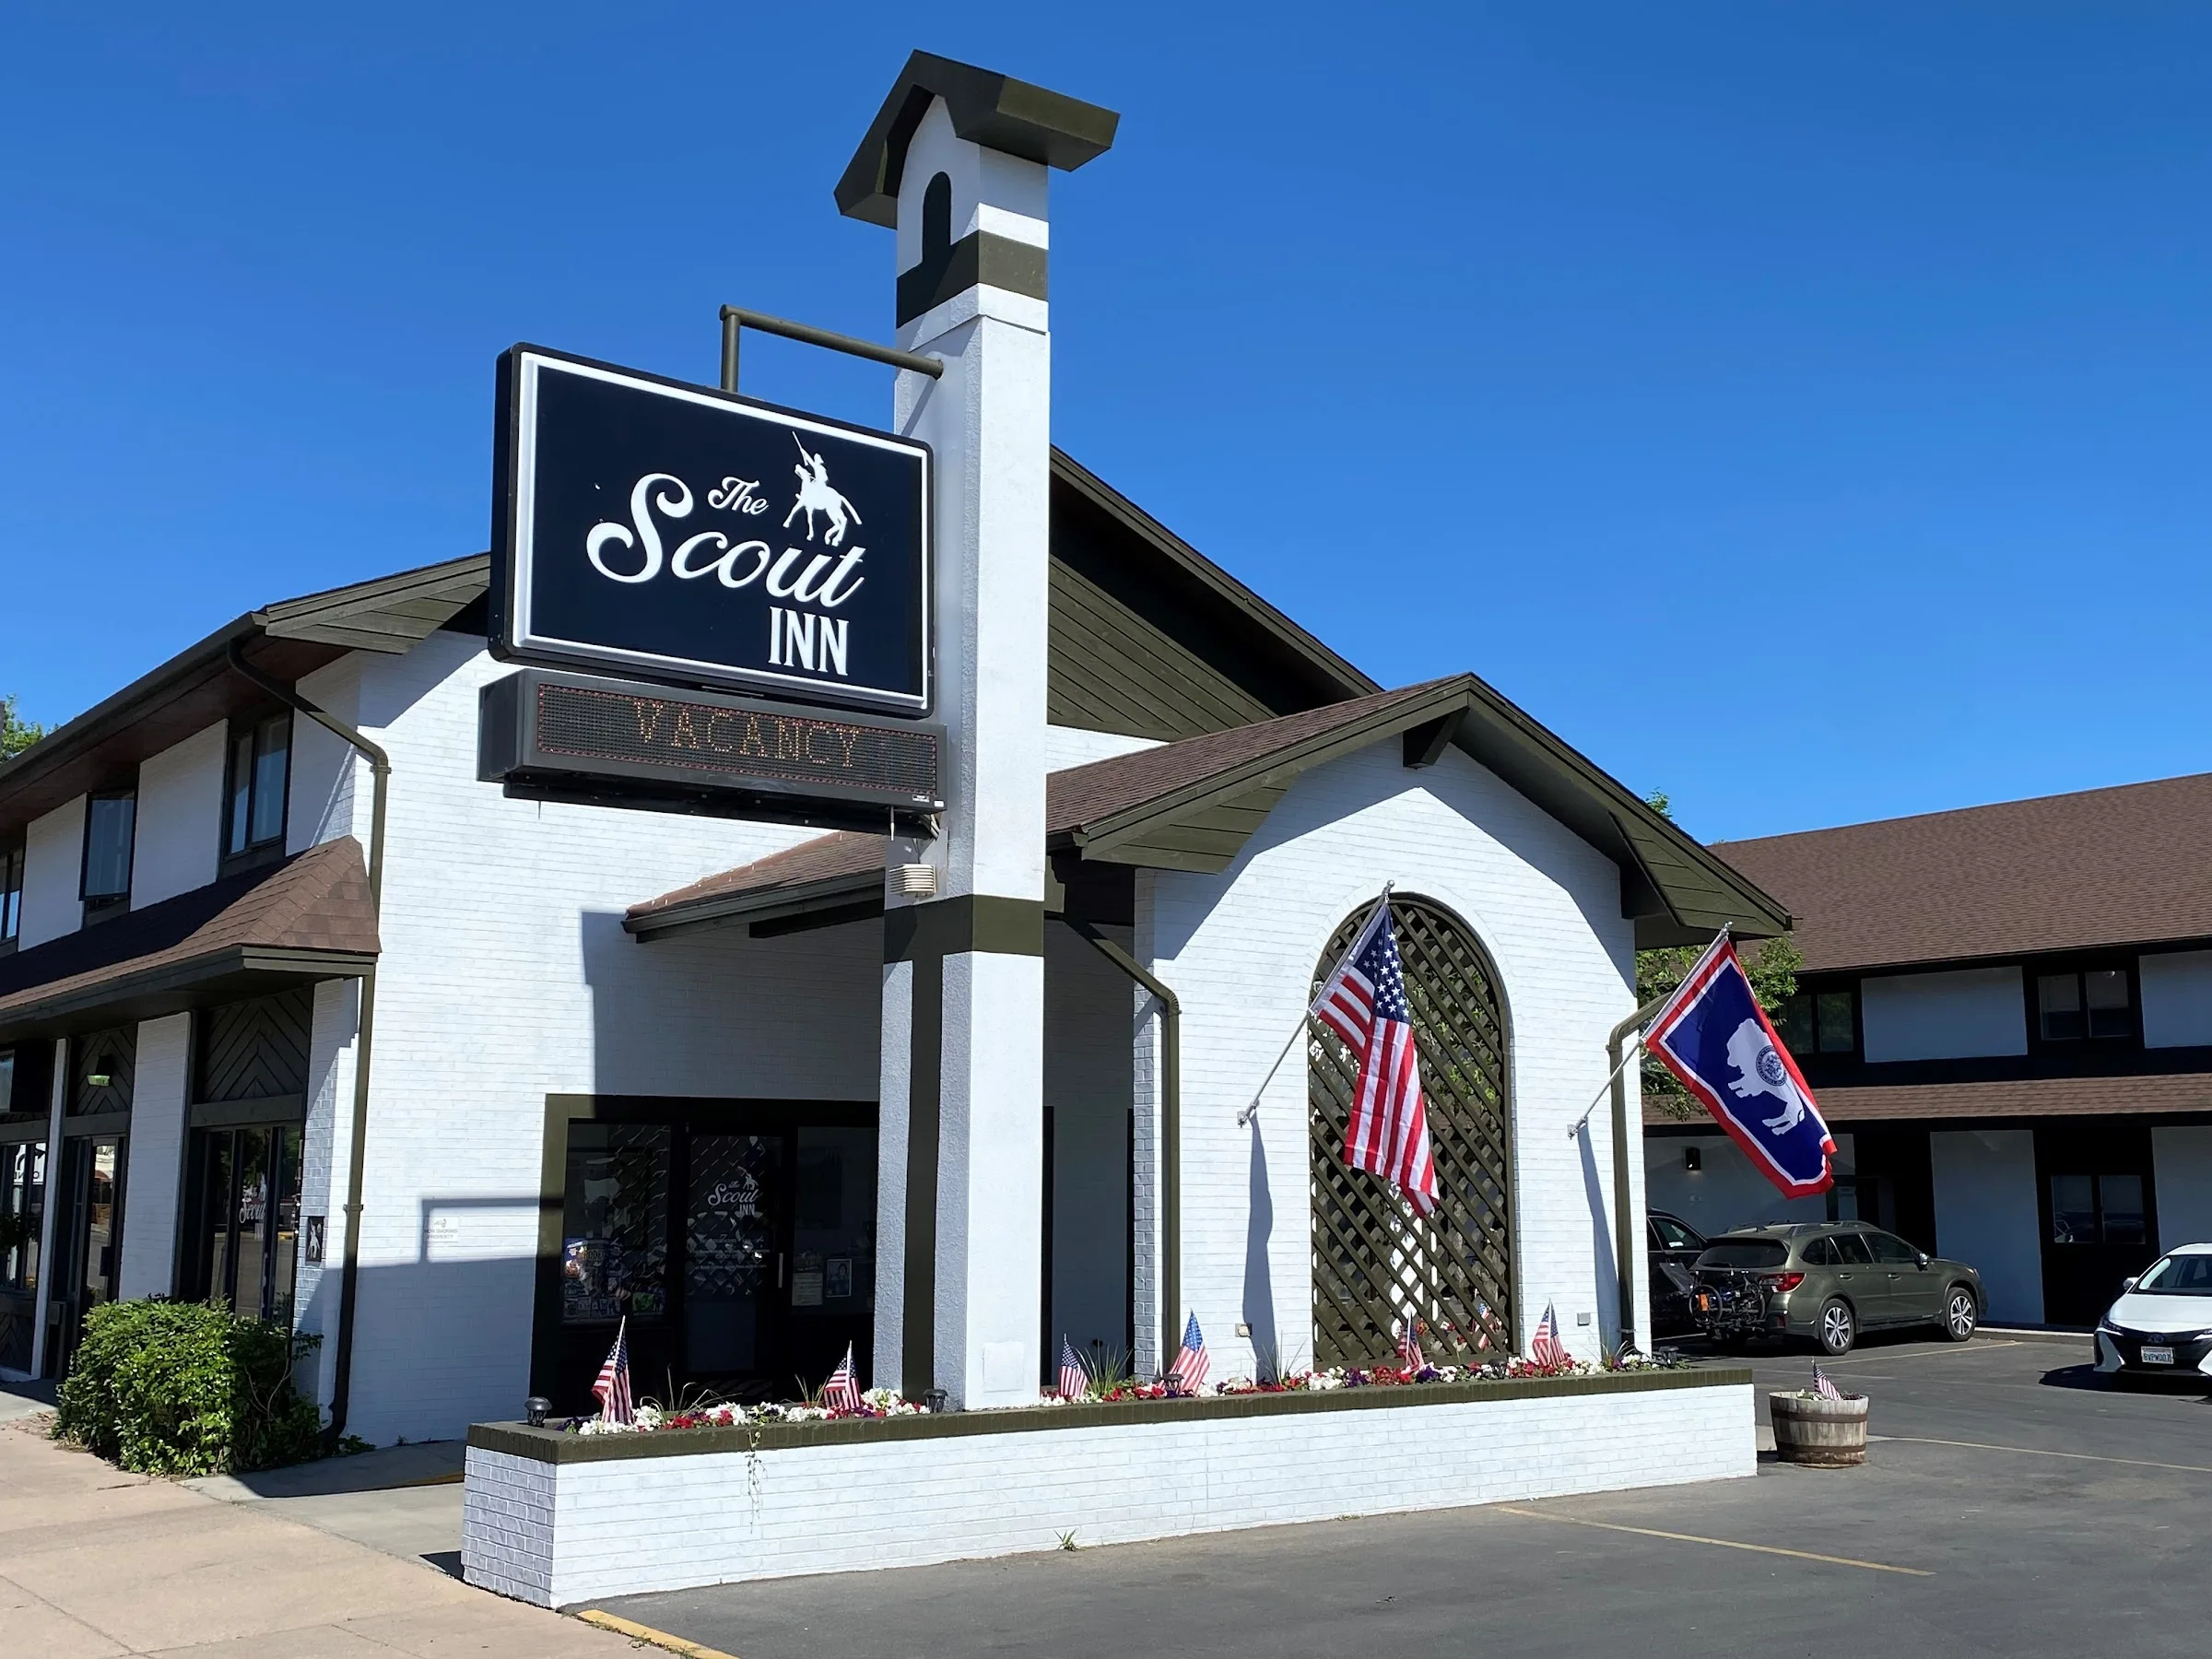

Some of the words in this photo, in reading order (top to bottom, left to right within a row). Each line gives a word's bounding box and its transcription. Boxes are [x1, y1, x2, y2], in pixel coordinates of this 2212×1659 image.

[708, 477, 769, 515] The
[586, 473, 866, 607] Scout
[768, 606, 849, 677] INN
[634, 700, 861, 769] VACANCY
[707, 1183, 759, 1206] Scout
[739, 1204, 756, 1216] INN
